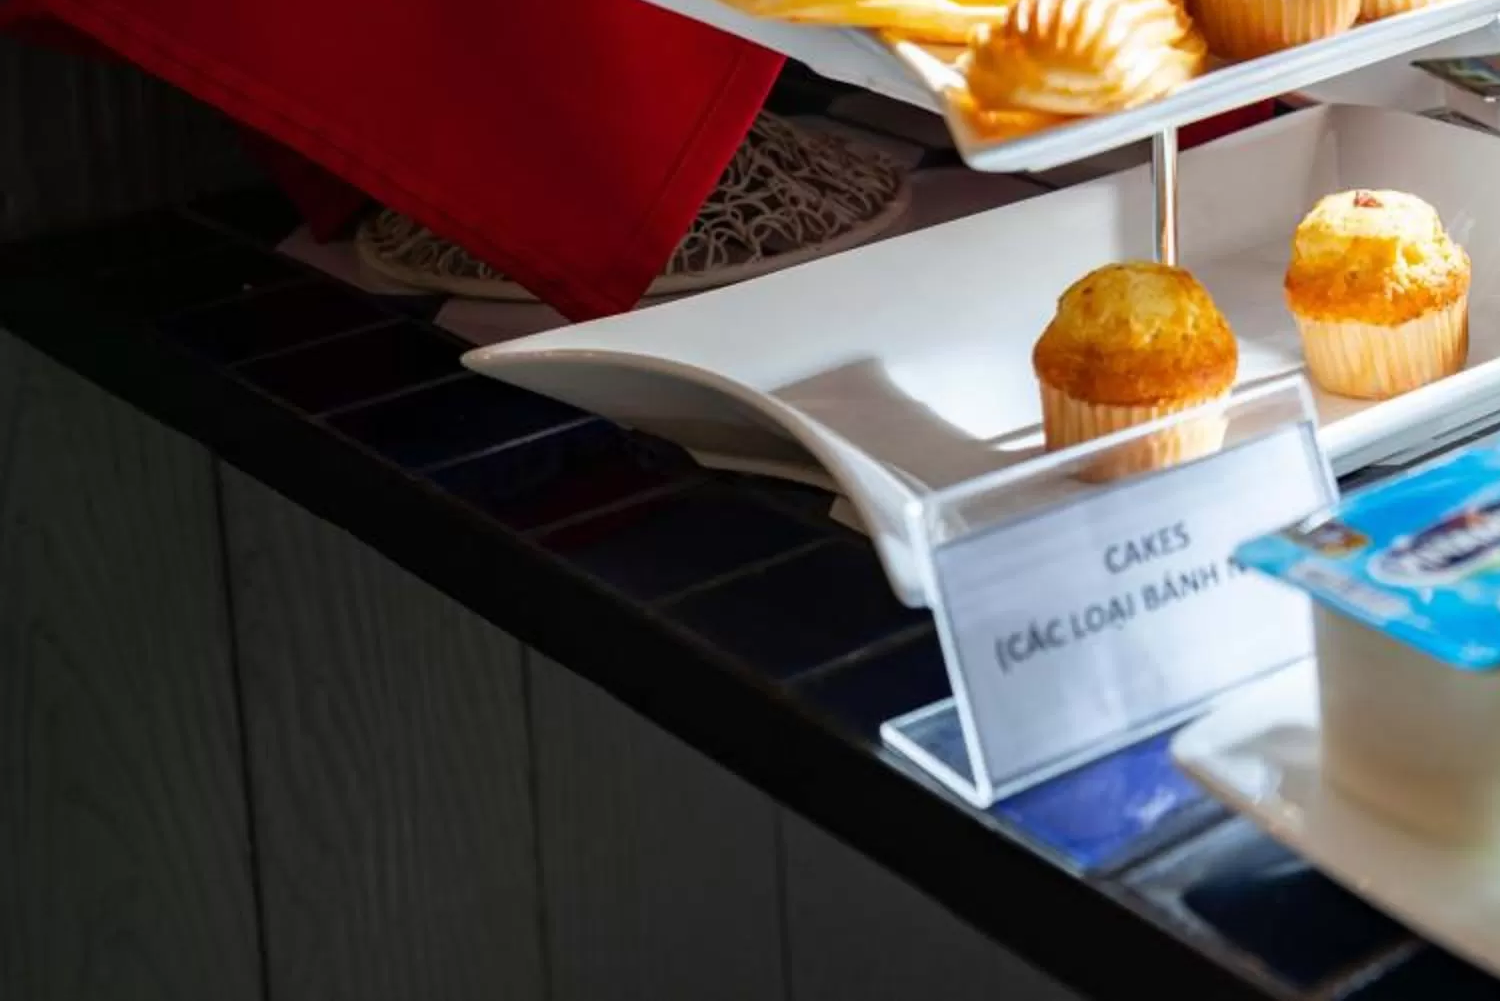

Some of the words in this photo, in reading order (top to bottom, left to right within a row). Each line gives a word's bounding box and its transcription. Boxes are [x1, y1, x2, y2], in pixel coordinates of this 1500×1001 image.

[1104, 522, 1192, 574] CAKES
[993, 620, 1067, 675] (CÁC
[1070, 594, 1137, 642] LOẠI
[1143, 561, 1219, 611] BÁNH
